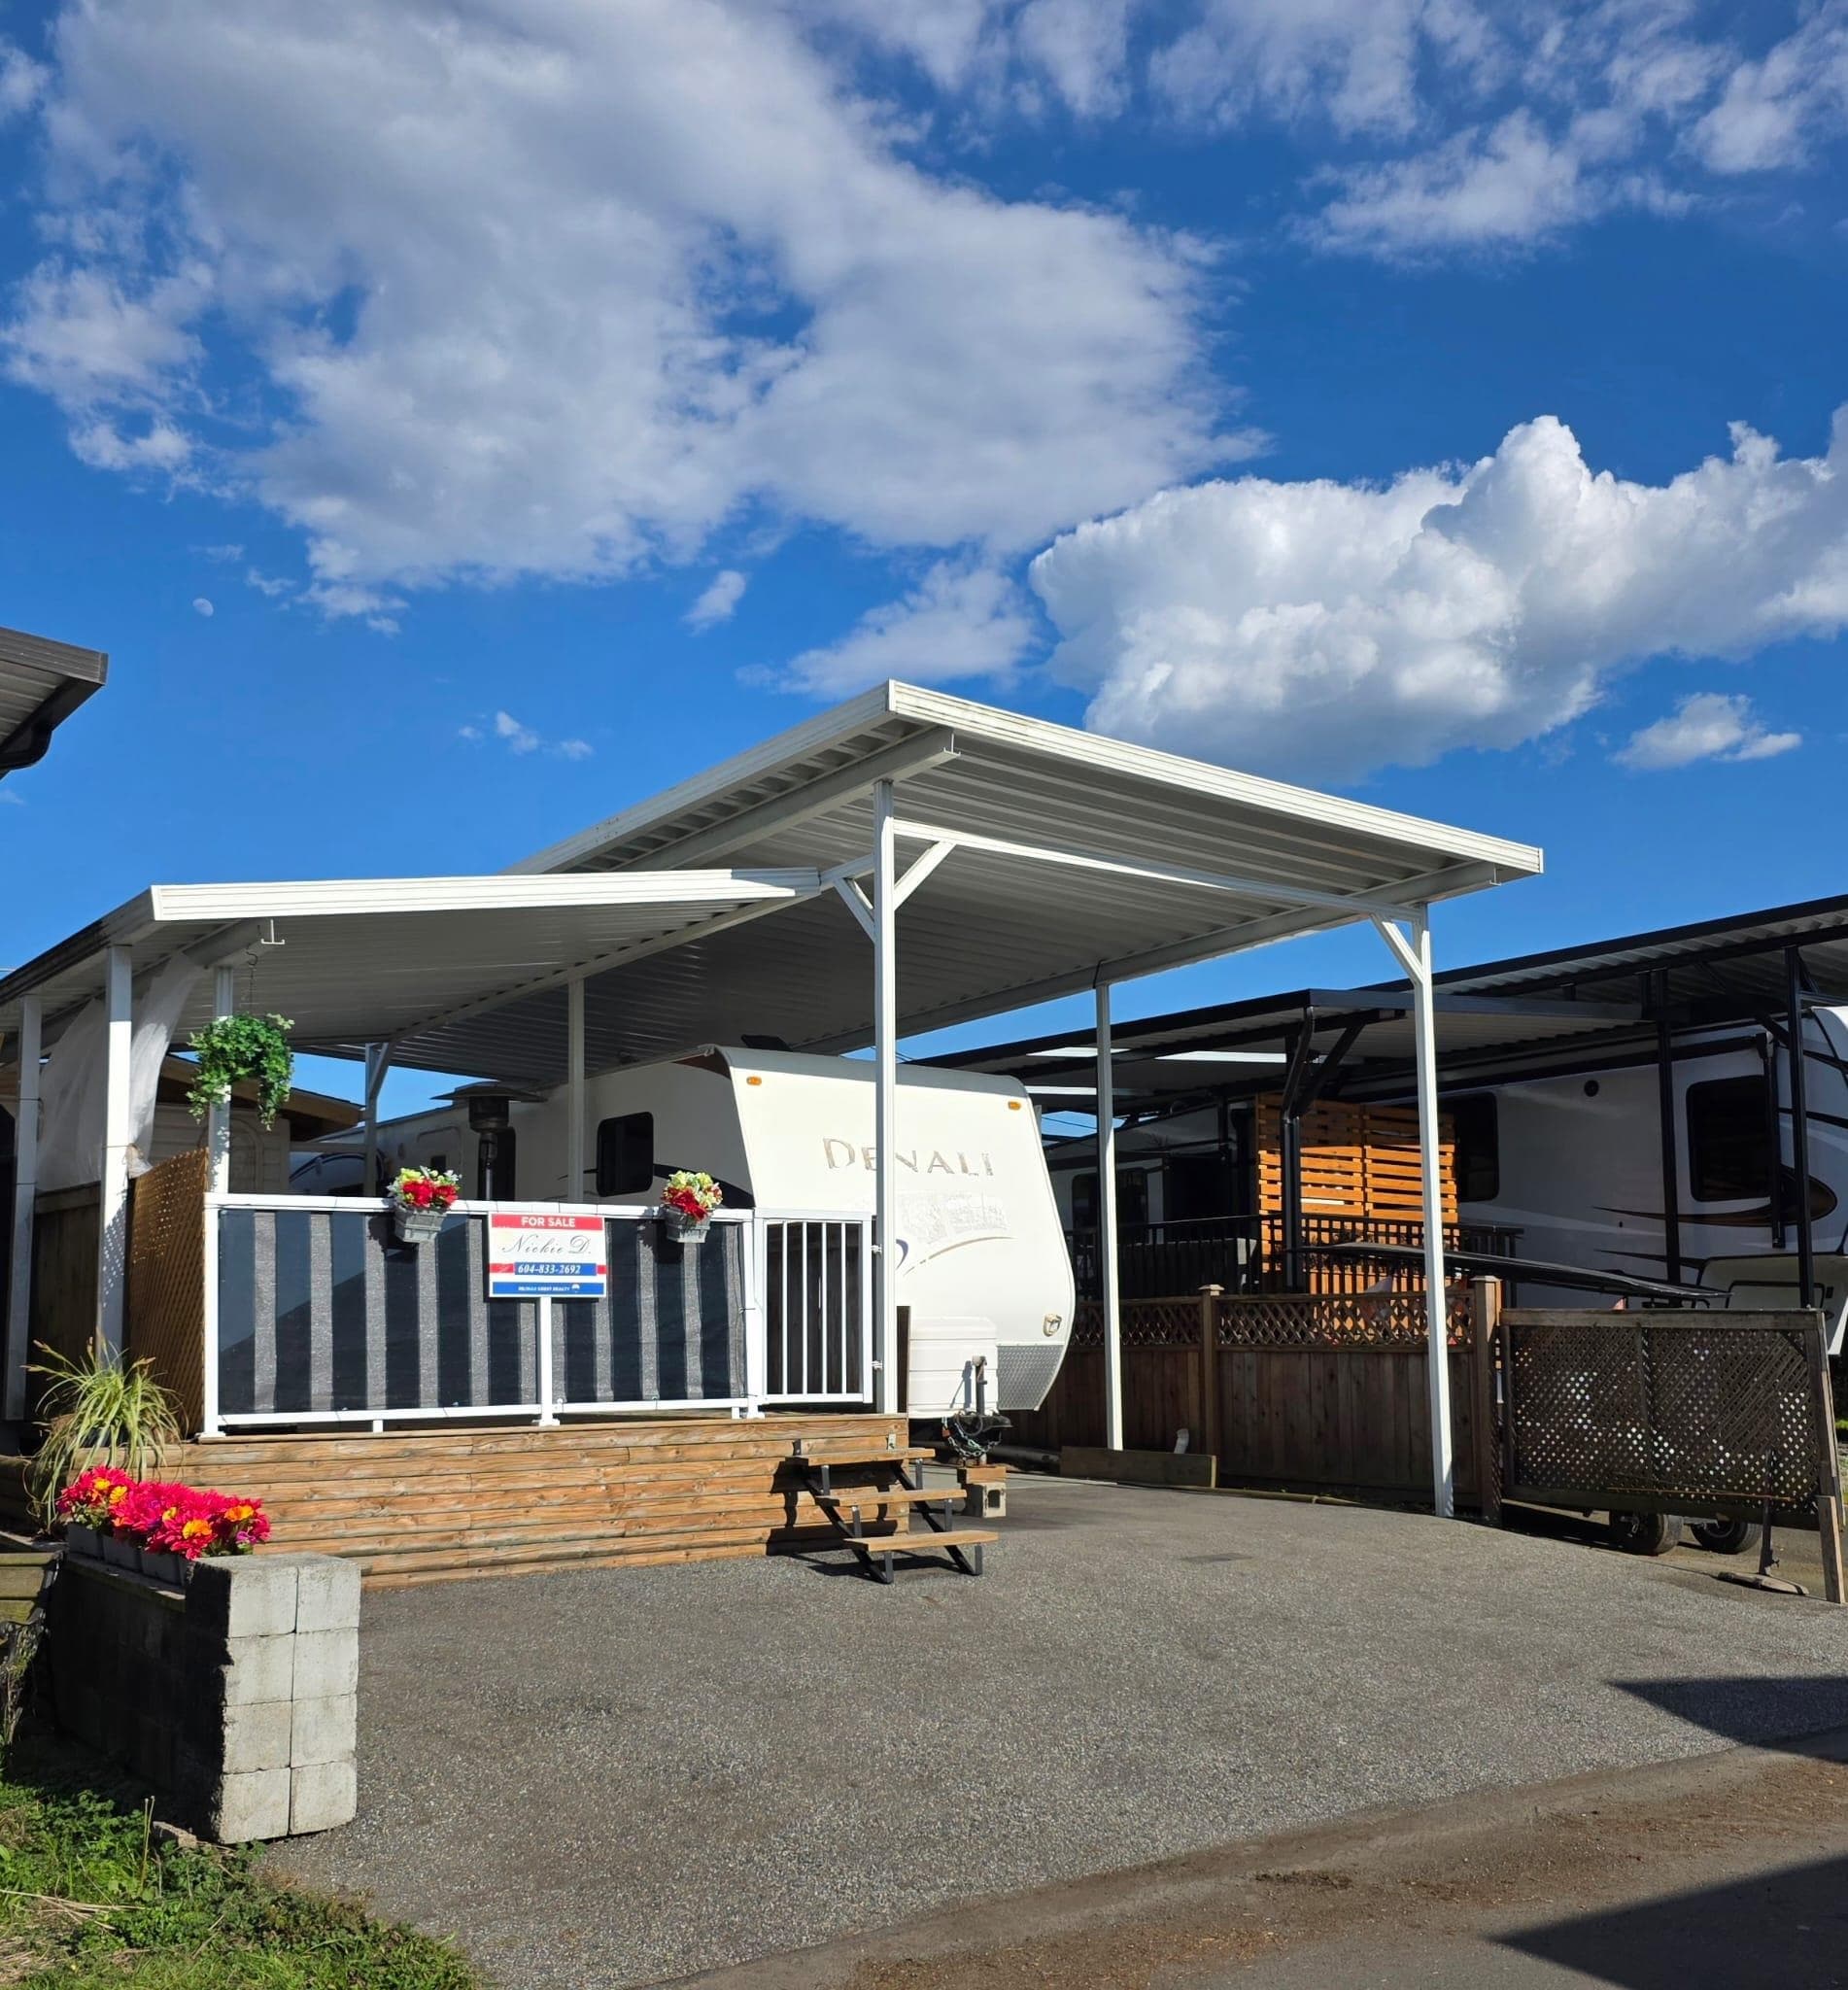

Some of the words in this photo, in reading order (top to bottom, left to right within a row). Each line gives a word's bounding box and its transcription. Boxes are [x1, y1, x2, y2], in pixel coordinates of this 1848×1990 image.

[823, 1138, 993, 1177] DENALI
[522, 1217, 545, 1226] FOR
[548, 1218, 575, 1227] SALE
[518, 1264, 581, 1275] 604-833-2692
